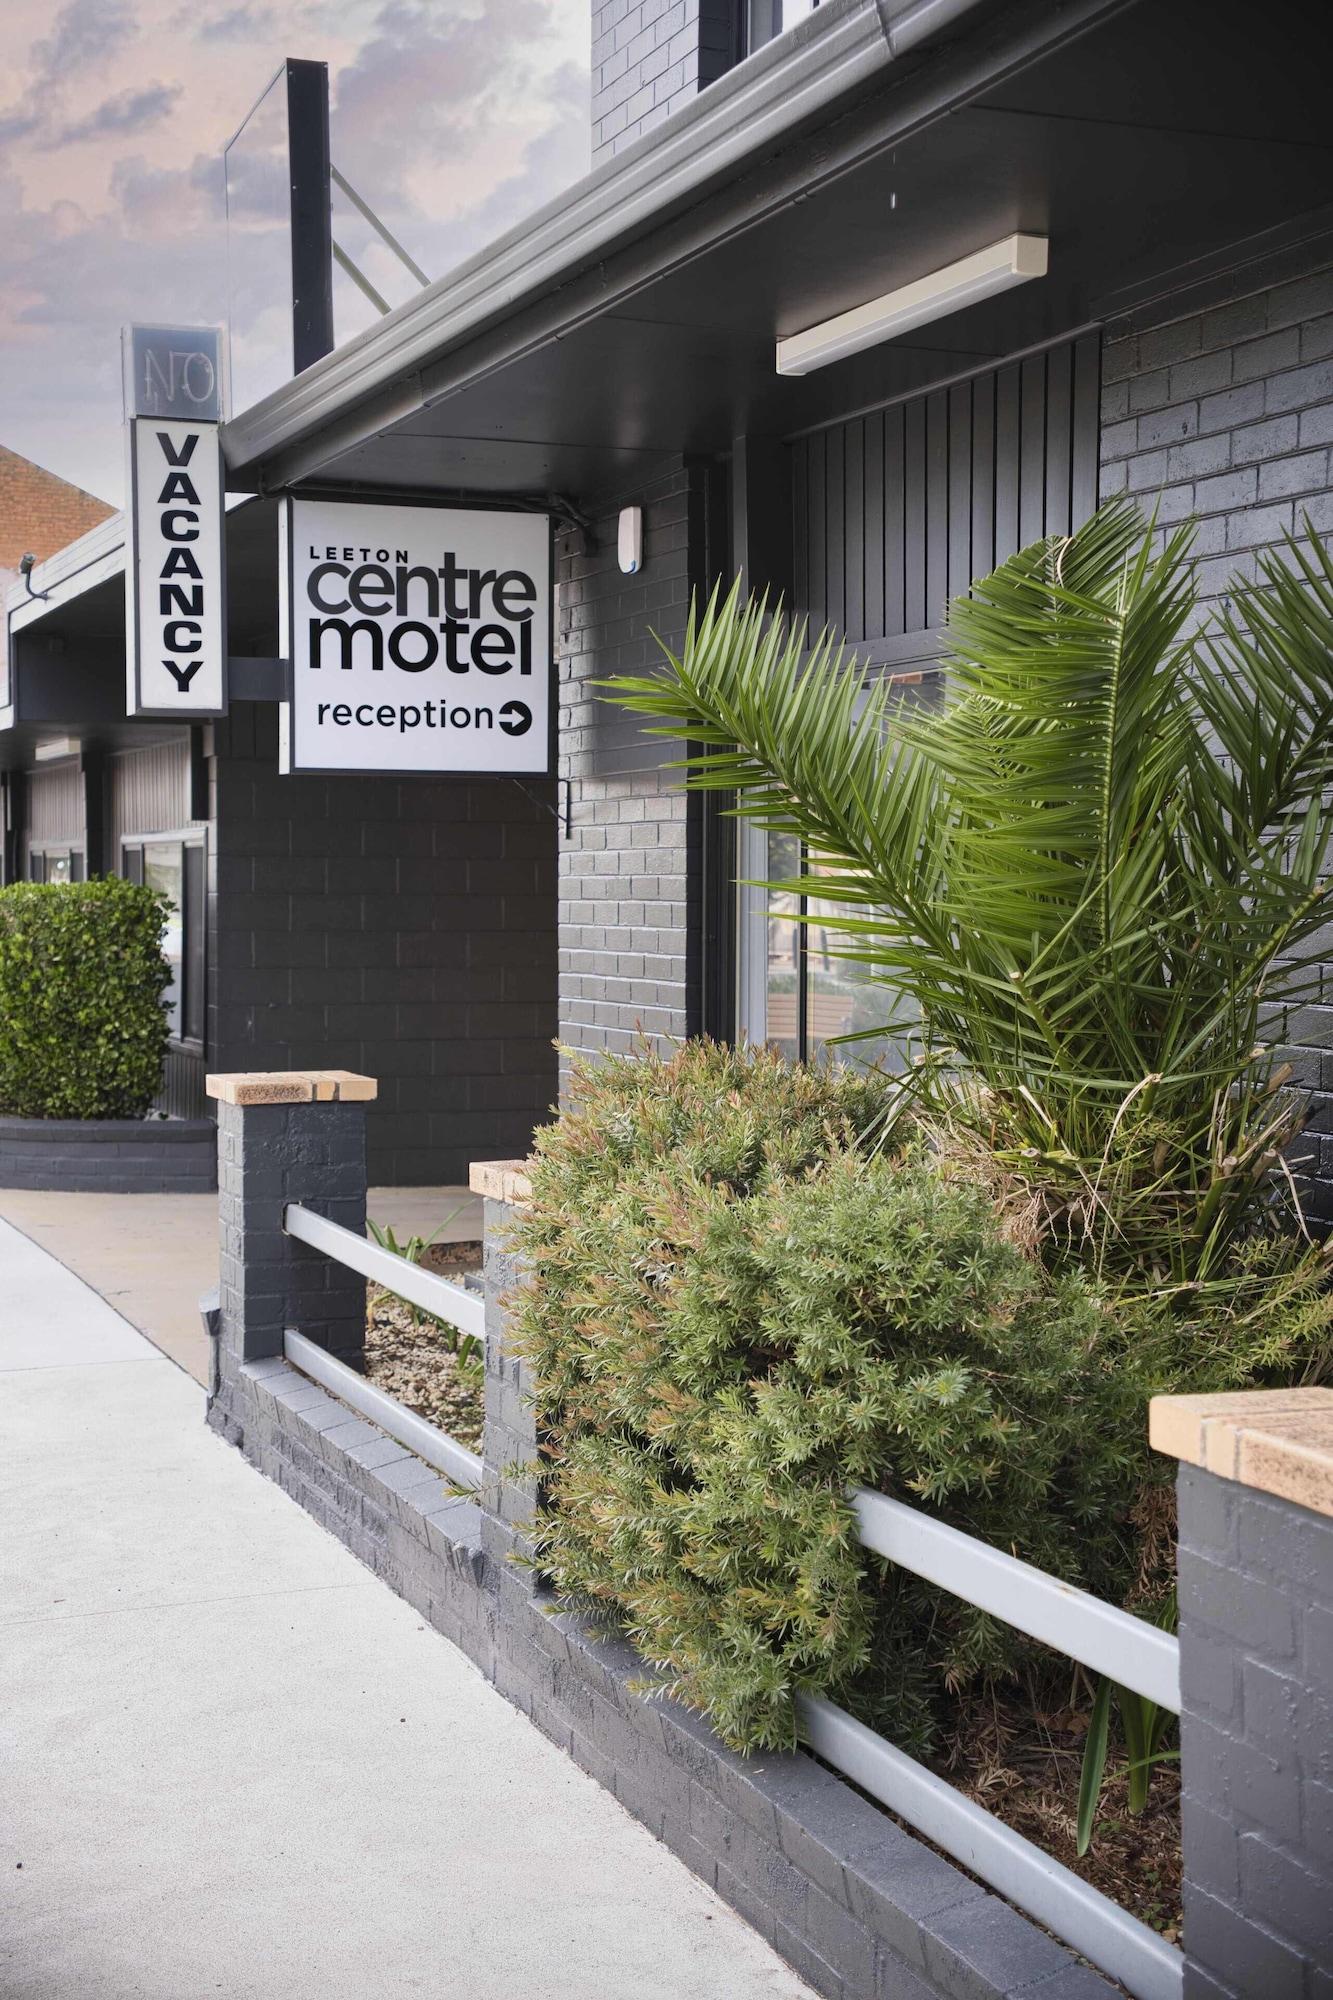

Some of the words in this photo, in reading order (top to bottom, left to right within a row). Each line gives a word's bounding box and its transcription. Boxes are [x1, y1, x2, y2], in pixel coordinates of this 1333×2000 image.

[144, 350, 215, 403] NO
[156, 432, 204, 692] VACANCY
[309, 546, 409, 564] LEETON
[307, 552, 537, 621] centre
[309, 616, 532, 675] motel
[317, 699, 493, 732] reception
